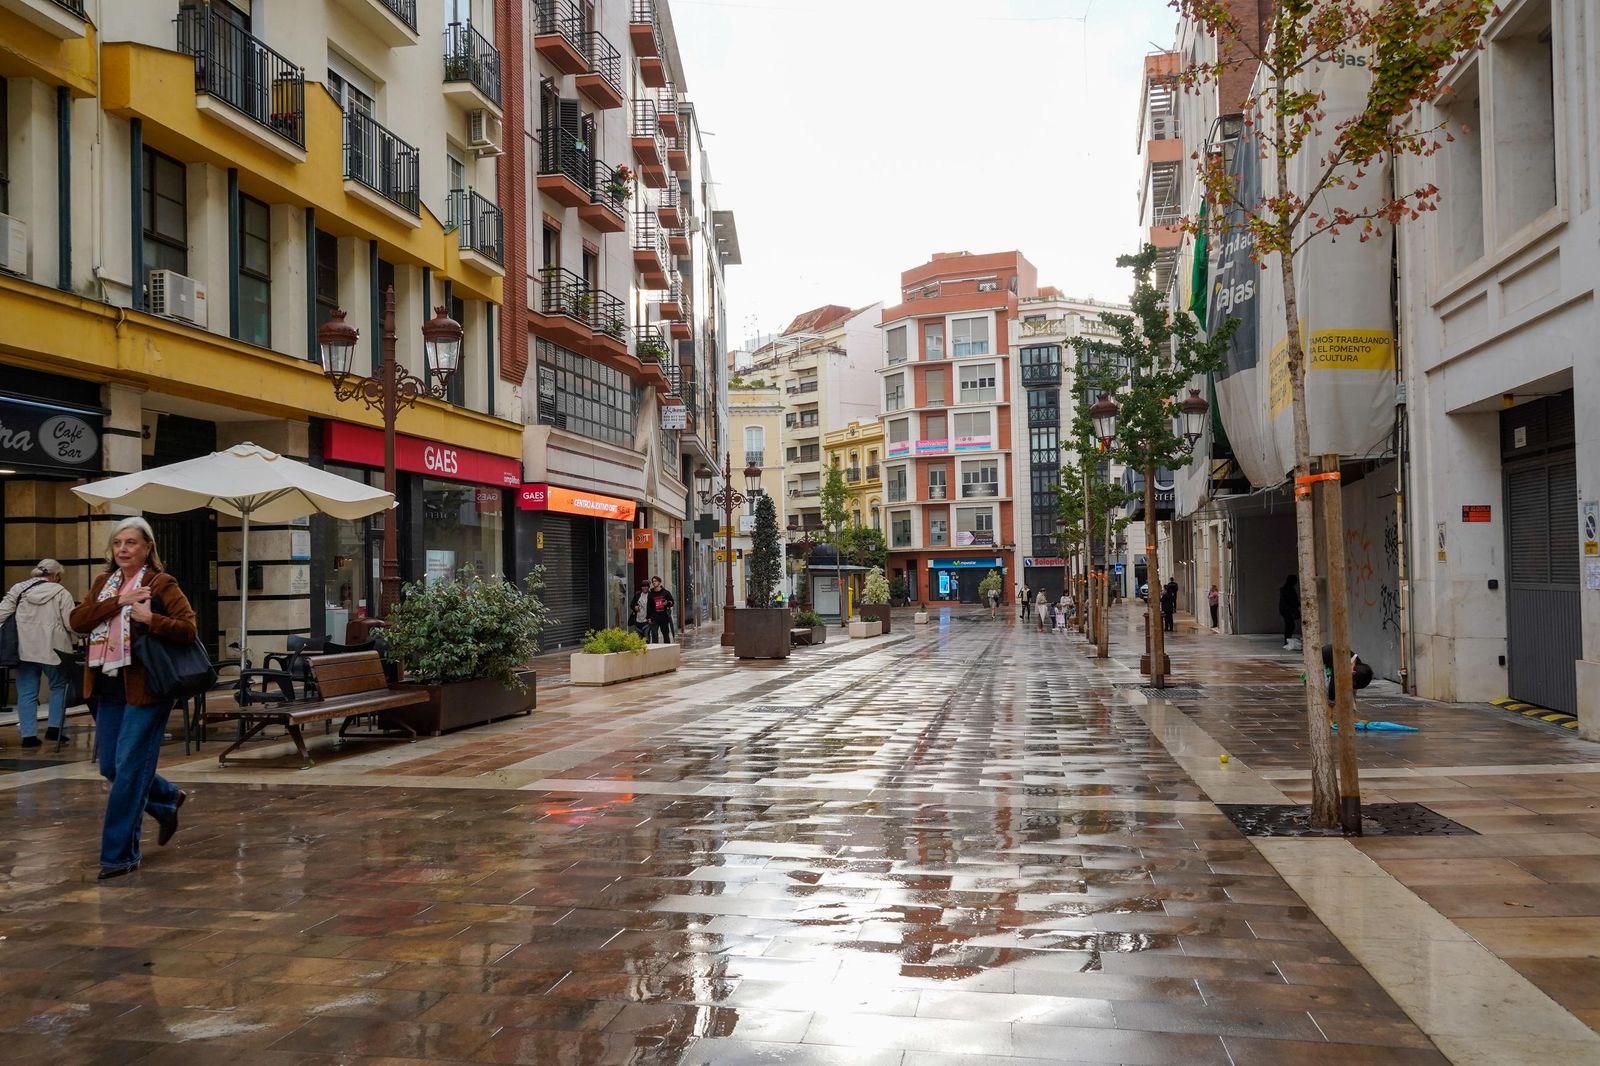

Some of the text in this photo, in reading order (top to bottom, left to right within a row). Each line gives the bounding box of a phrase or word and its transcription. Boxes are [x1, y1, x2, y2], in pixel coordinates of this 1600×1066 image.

[1335, 336, 1390, 345] TRABAJANDO
[1317, 345, 1328, 353] EL
[1329, 345, 1372, 353] FOMENTO
[53, 421, 84, 443] Café
[57, 441, 82, 458] Bar
[424, 446, 458, 474] GAES
[522, 491, 544, 500] GAES
